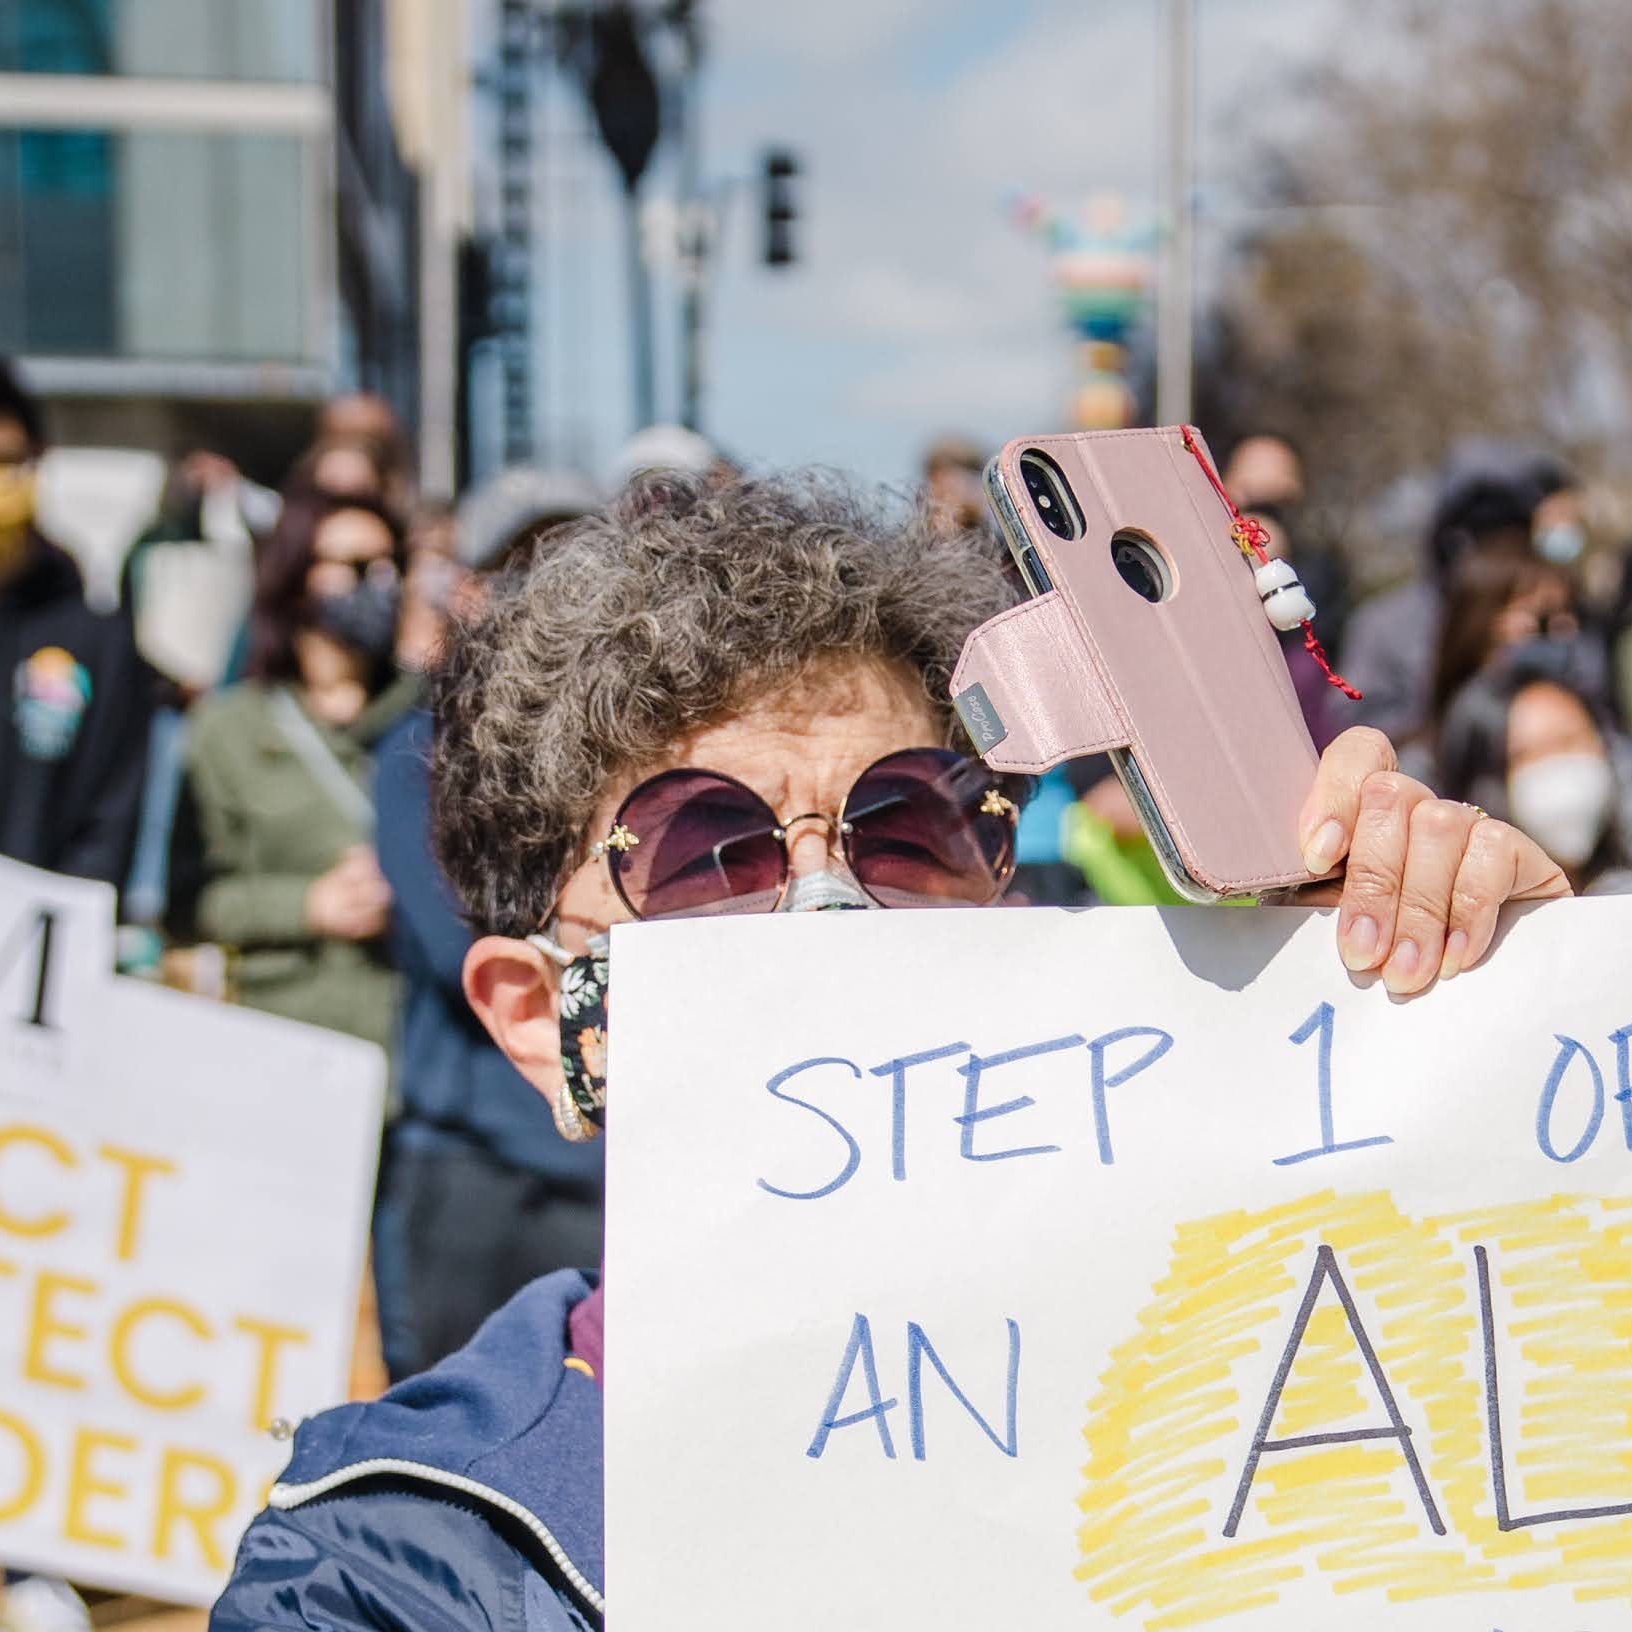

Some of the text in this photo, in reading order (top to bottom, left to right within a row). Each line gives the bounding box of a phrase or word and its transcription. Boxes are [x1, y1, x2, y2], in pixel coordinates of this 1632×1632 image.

[967, 695, 996, 741] ProCase
[758, 1023, 1173, 1201] STEP
[1273, 1000, 1393, 1168] 1
[806, 1311, 1020, 1461] AN
